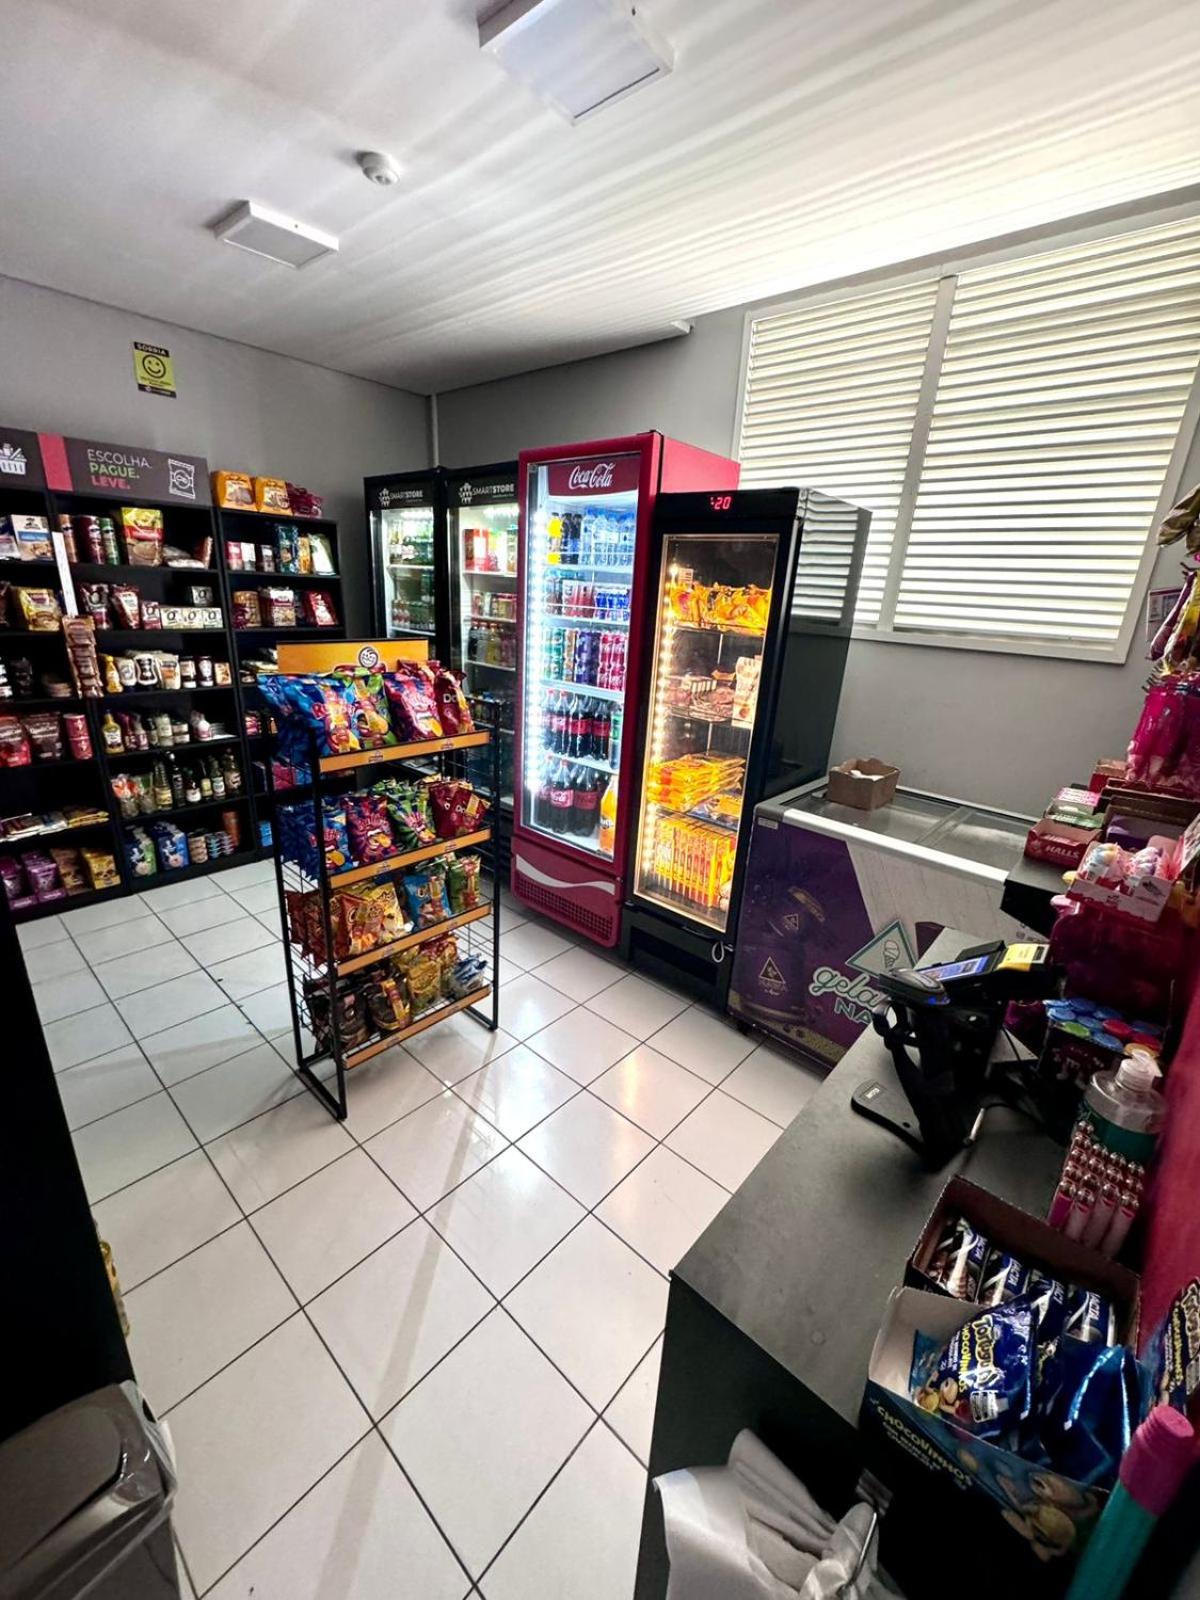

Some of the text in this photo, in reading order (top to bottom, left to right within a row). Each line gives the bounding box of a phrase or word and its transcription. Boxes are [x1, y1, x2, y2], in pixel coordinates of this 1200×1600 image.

[89, 462, 140, 479] PAGUE.
[91, 475, 131, 490] LEVE.
[1045, 844, 1080, 859] HALLS
[1008, 1258, 1022, 1286] LACTA
